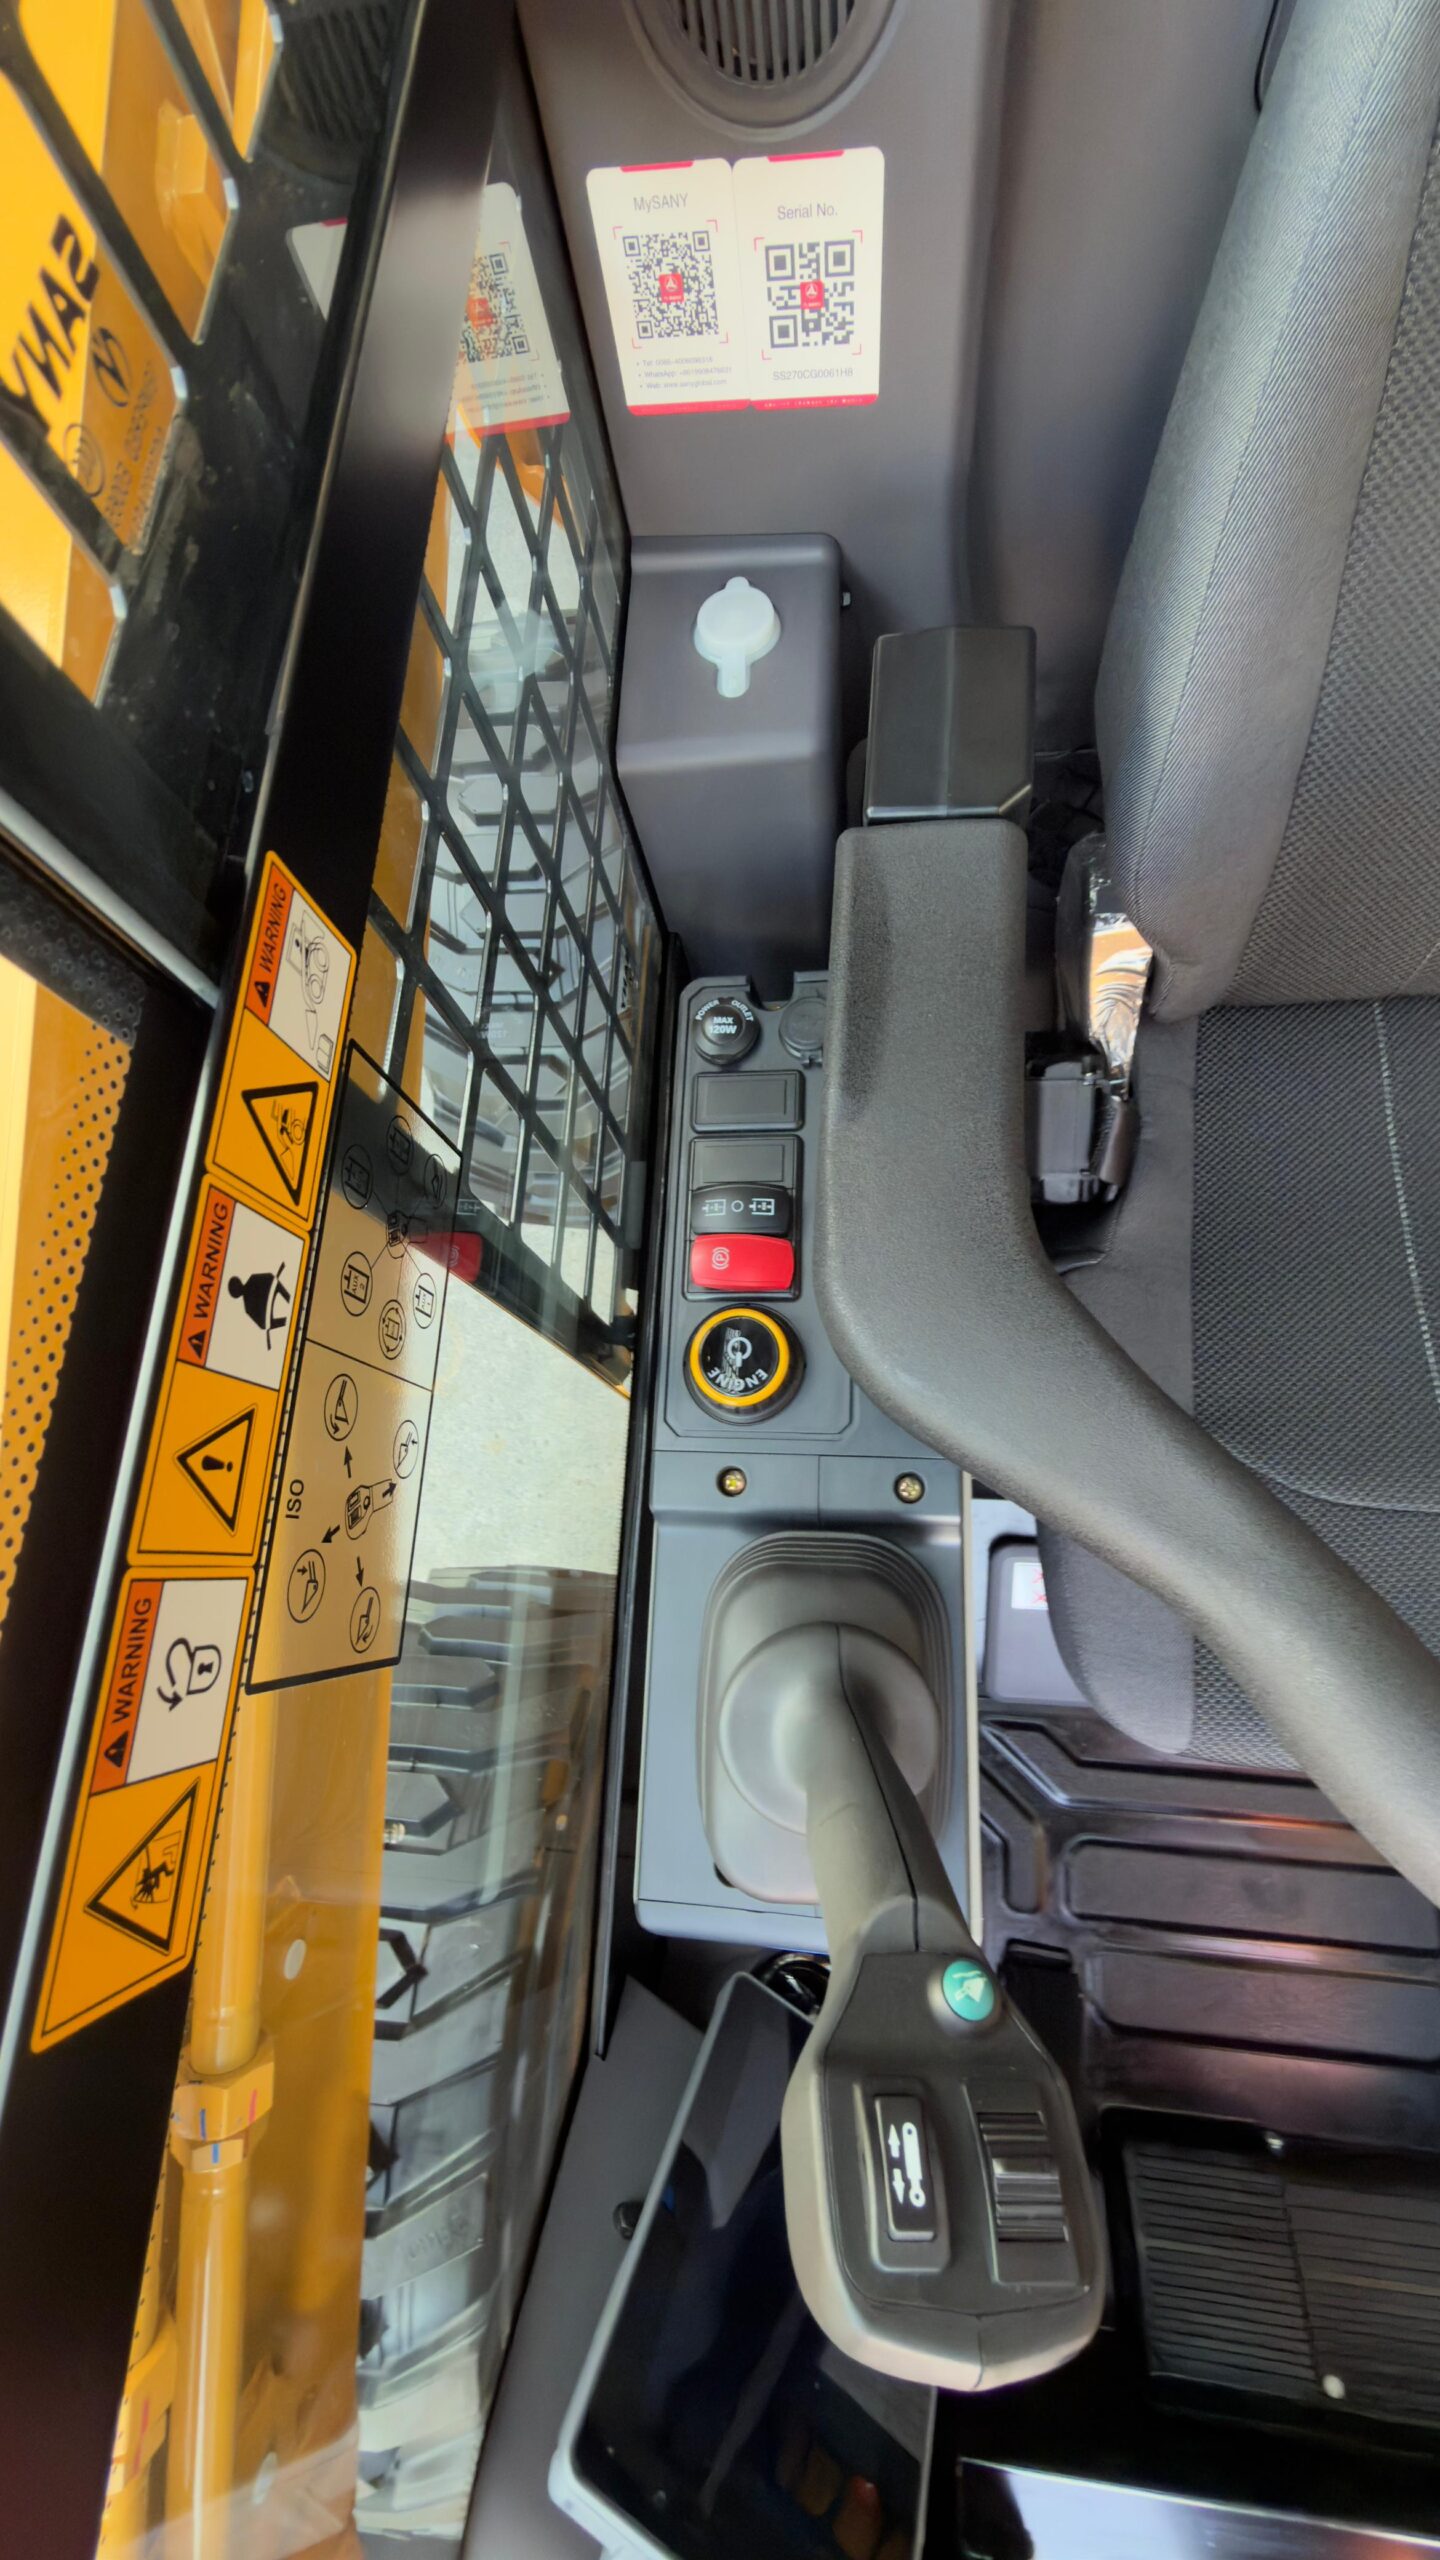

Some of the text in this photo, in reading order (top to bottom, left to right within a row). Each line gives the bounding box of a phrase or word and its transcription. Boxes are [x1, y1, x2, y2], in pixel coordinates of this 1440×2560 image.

[633, 193, 689, 213] MySANY
[777, 203, 838, 220] Serial No.
[259, 883, 287, 973] WARNING
[695, 999, 754, 1022] POWER OUTLET
[713, 1016, 734, 1024] MAX
[710, 1025, 738, 1034] 120W
[193, 1202, 228, 1319] WARNING
[351, 1273, 360, 1294] AUX
[707, 1366, 769, 1392] ENGINE
[285, 1479, 304, 1519] ISO
[112, 1598, 152, 1723] WARNING
